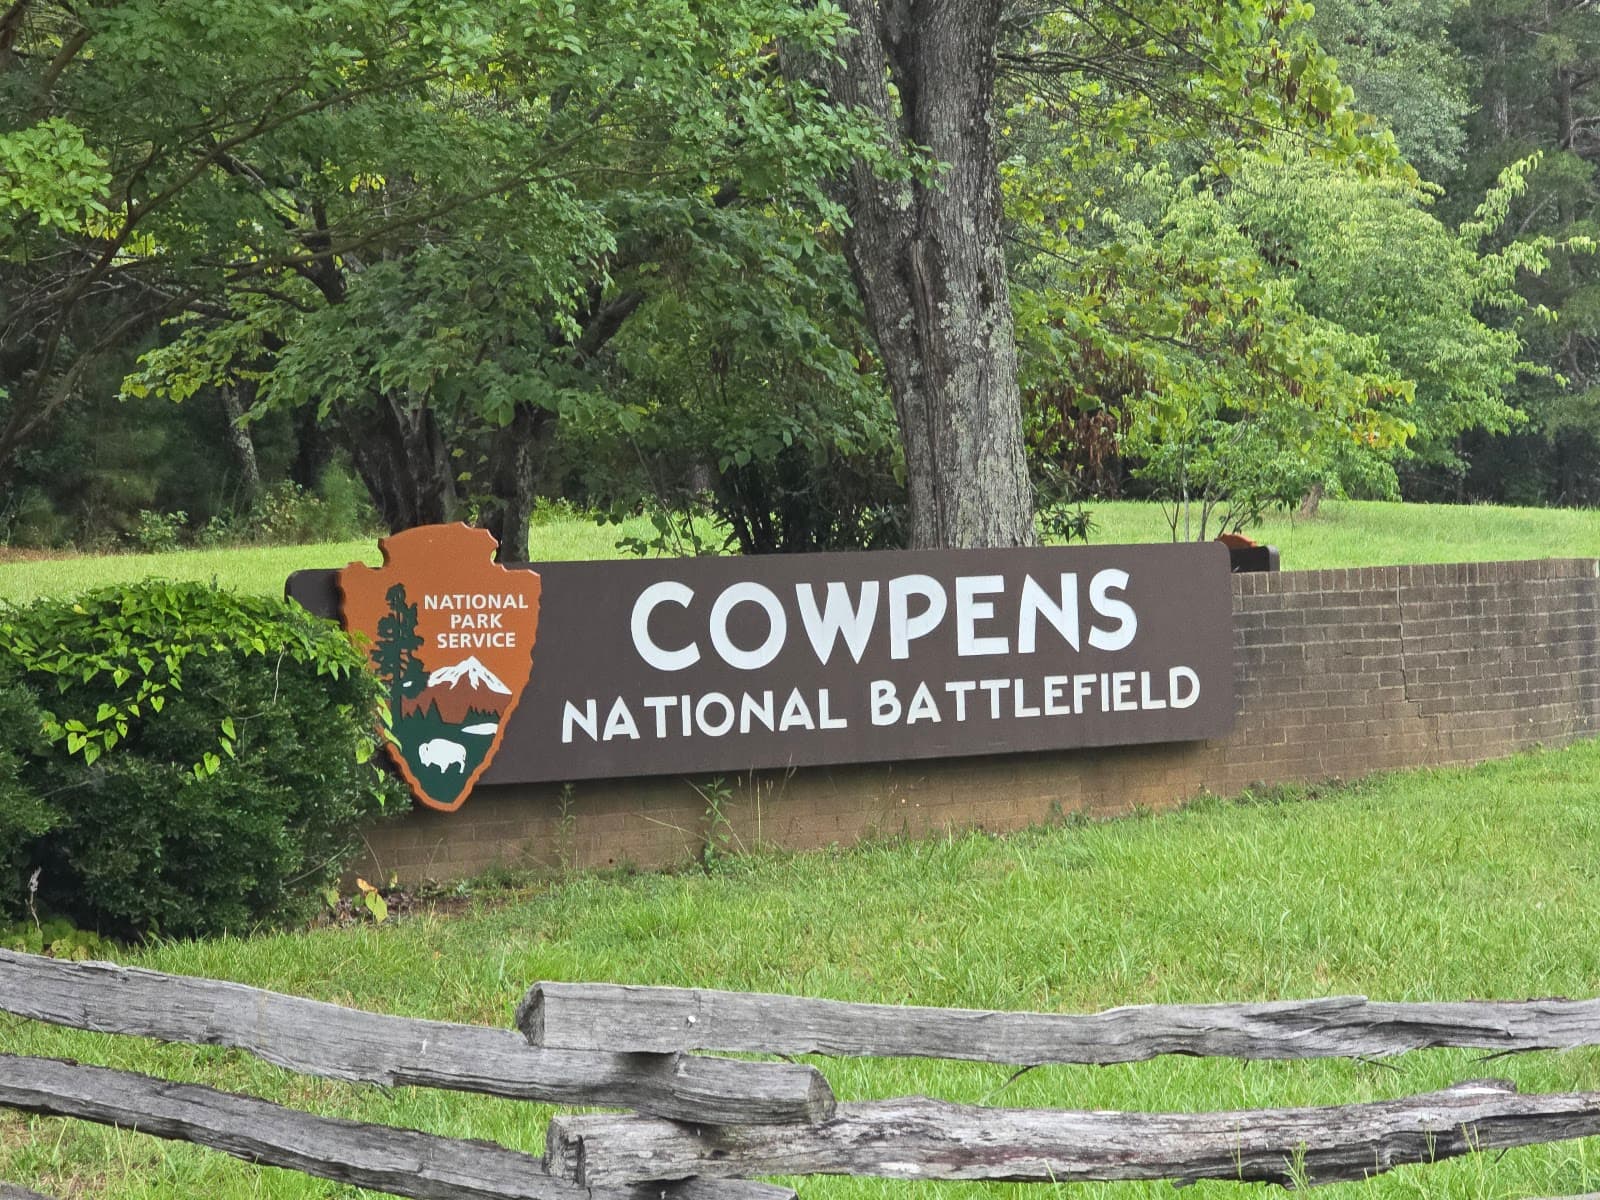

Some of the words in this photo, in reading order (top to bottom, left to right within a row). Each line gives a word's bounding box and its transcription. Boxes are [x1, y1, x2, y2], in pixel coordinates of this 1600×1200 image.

[423, 594, 529, 610] NATIONAL
[450, 613, 502, 629] PARK
[630, 568, 1138, 672] COWPENS
[437, 632, 516, 649] SERVICE
[561, 687, 848, 744] NATIONAL
[870, 665, 1201, 726] BATTLEFIELD
